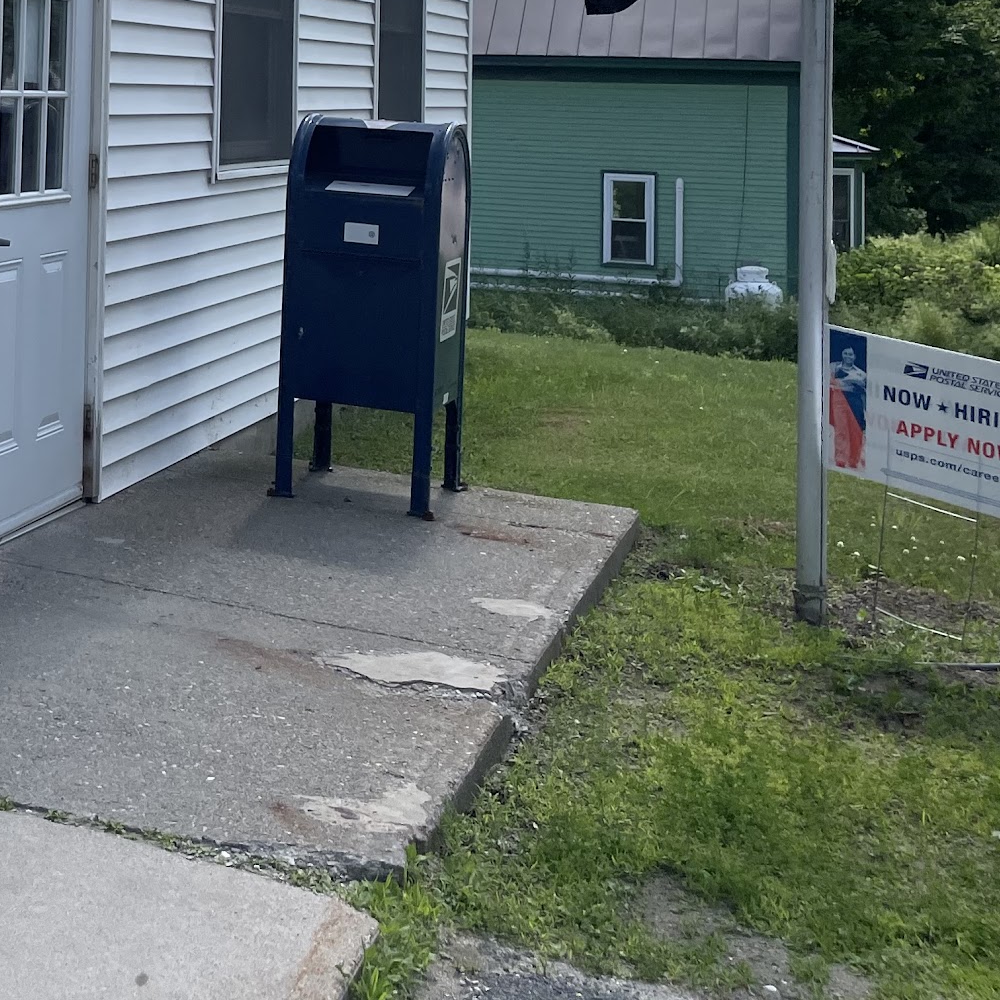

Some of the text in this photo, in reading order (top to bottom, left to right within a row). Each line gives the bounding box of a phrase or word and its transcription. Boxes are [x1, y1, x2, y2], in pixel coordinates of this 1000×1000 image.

[929, 375, 966, 390] POSTAL
[932, 368, 970, 382] UNITED
[883, 385, 931, 411] NOW
[896, 420, 1000, 461] APPLY NO
